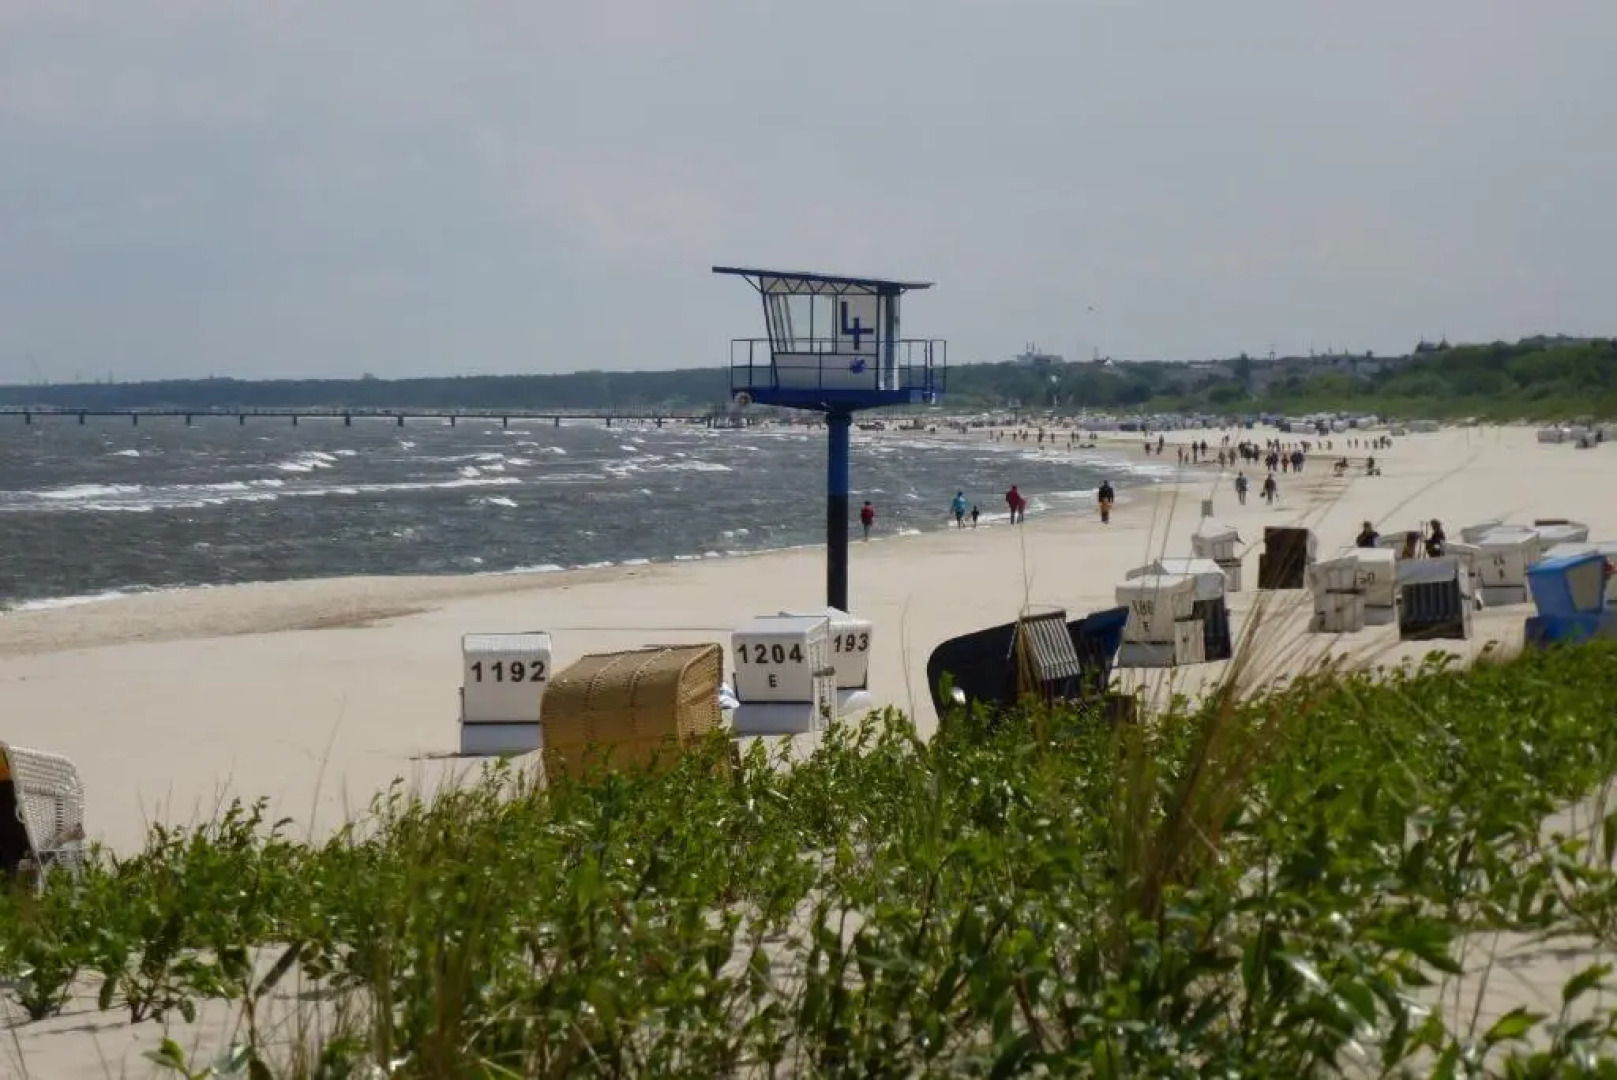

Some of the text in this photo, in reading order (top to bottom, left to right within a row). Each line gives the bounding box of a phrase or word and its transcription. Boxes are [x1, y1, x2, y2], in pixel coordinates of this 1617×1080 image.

[841, 301, 874, 350] 4
[834, 632, 869, 653] 193
[738, 644, 804, 664] 1204
[470, 660, 545, 683] 1192
[768, 674, 778, 688] E
